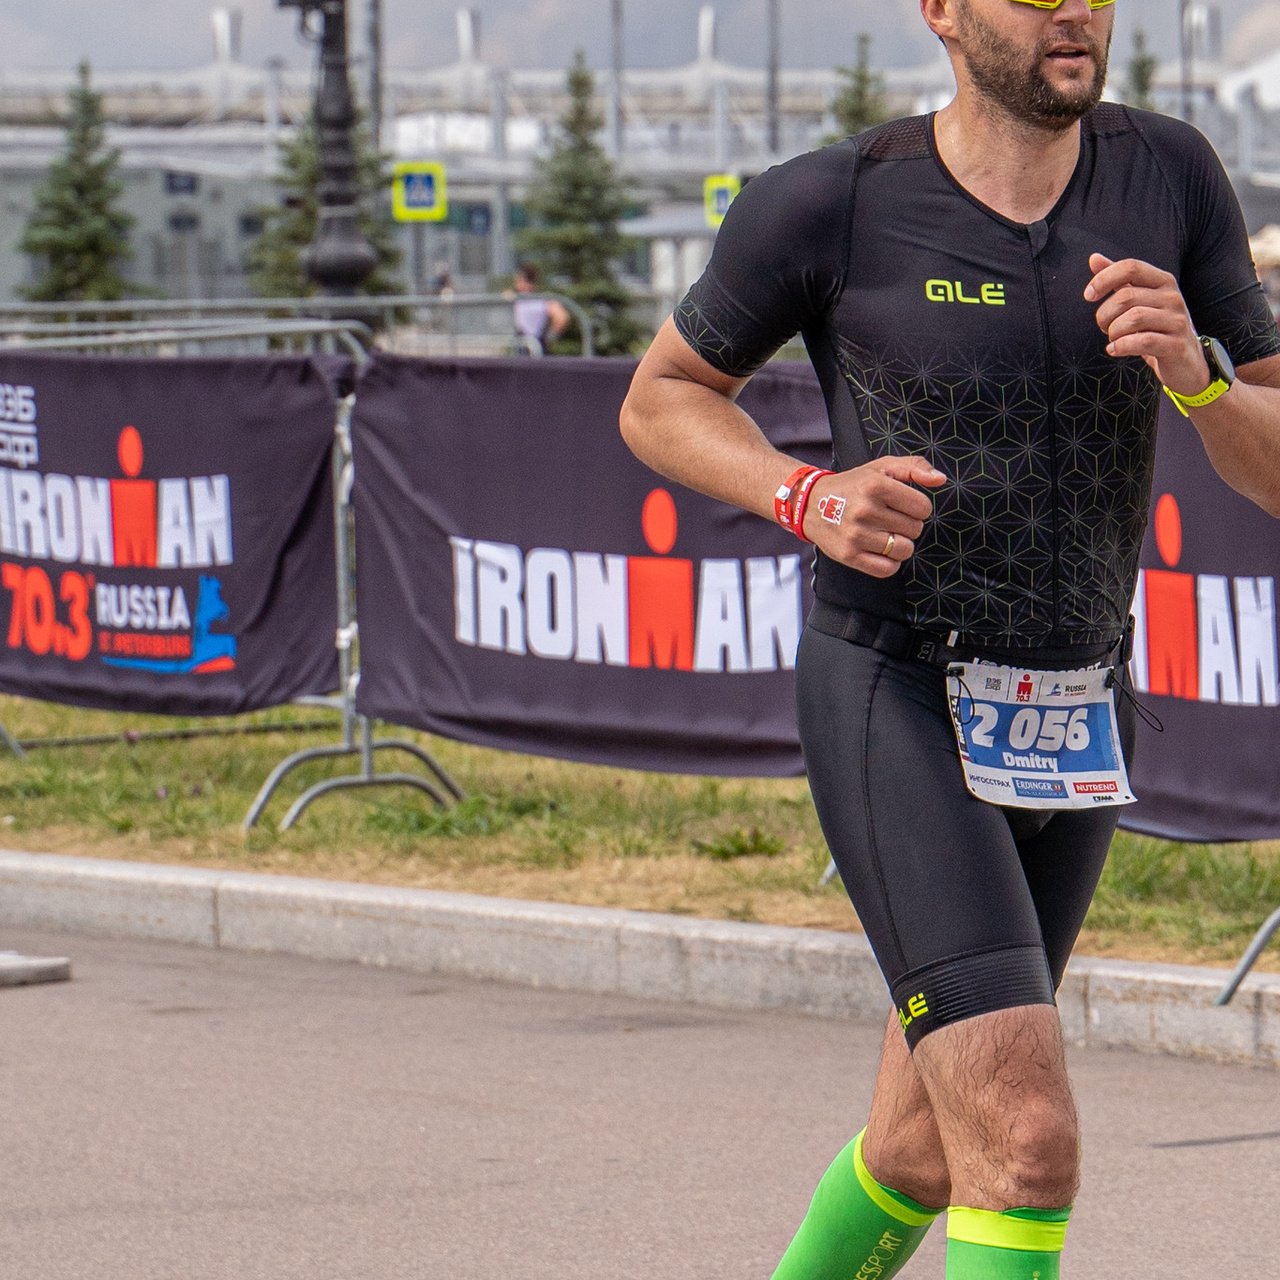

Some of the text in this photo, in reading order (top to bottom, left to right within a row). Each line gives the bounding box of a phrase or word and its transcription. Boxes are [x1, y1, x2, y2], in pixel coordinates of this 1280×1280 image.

[0, 466, 234, 569] IRONMAN
[2, 562, 191, 661] 70.3 RUSSIA
[449, 536, 801, 673] IRONMAN
[1002, 751, 1059, 773] Dmitry
[1016, 779, 1054, 791] ERDINGER
[1076, 783, 1116, 792] NUTREND
